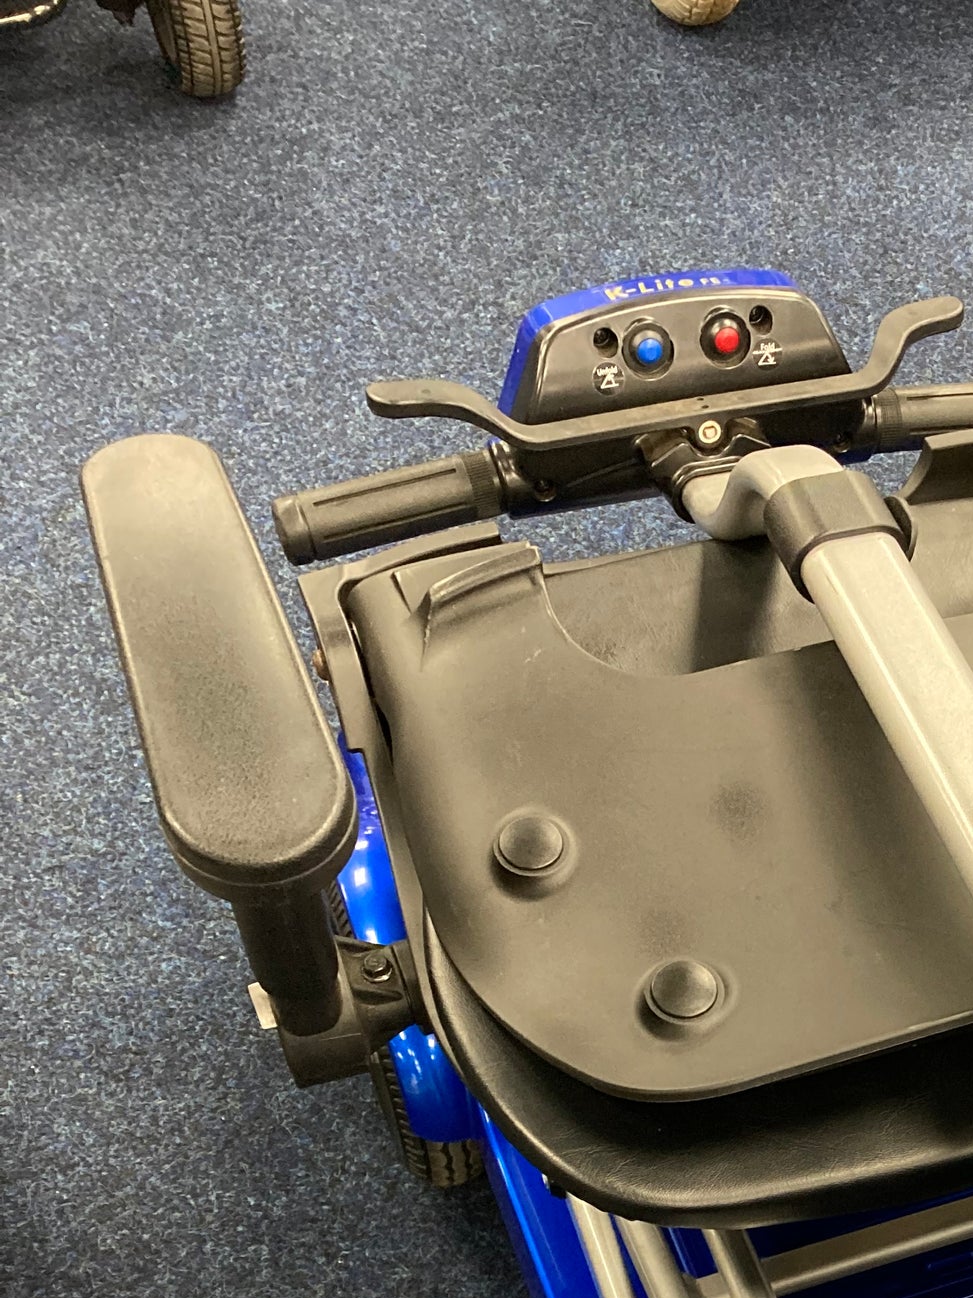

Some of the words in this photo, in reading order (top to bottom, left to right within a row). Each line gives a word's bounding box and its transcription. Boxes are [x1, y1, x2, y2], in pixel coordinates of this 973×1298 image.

[604, 279, 693, 300] K-Lite
[760, 342, 775, 351] Fold
[596, 365, 618, 376] Unfold
